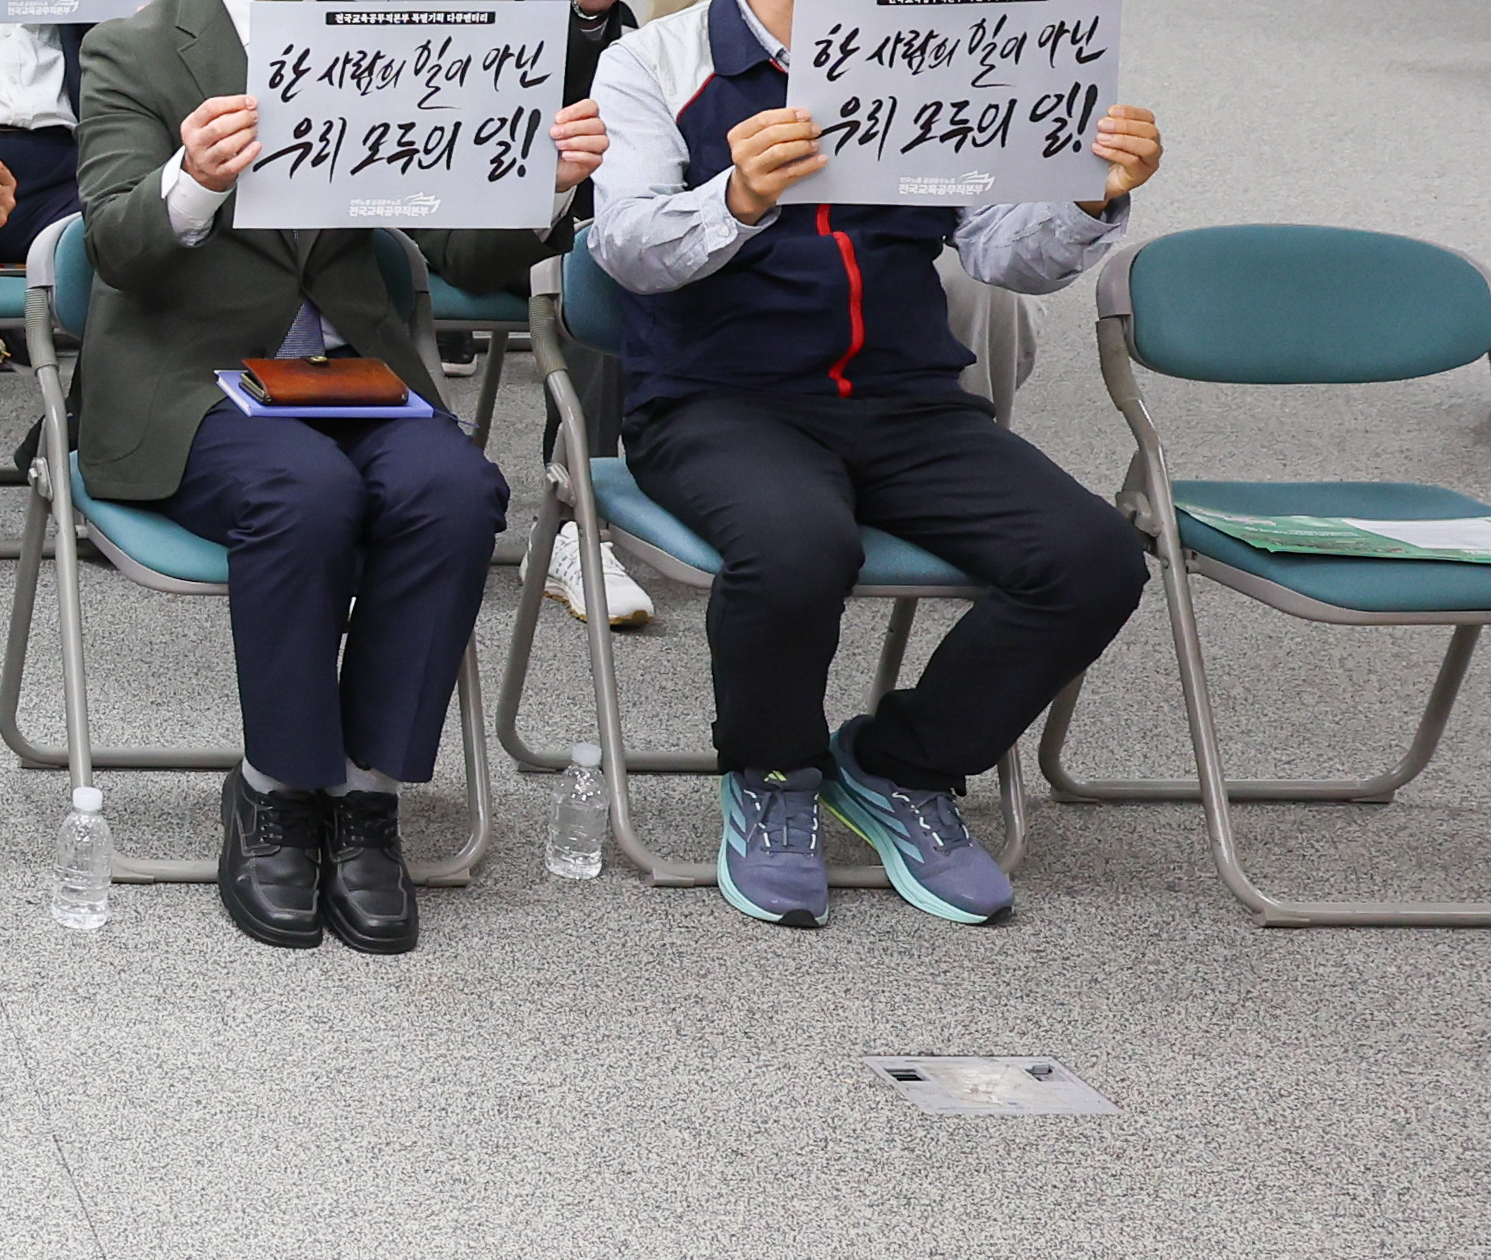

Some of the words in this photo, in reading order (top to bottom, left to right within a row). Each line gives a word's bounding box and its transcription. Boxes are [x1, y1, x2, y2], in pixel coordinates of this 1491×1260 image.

[269, 45, 311, 102] 한
[317, 50, 406, 96] 사람의
[414, 36, 471, 110] 일이
[482, 40, 550, 92] 아닌
[814, 24, 859, 82] 한
[866, 29, 960, 75] 사람의
[968, 14, 1027, 88] 일이
[1038, 16, 1105, 68] 아닌
[255, 117, 346, 183] 우리
[351, 121, 461, 175] 모두의
[473, 104, 540, 183] 일!
[817, 95, 898, 161] 우리
[901, 98, 1017, 155] 모두의
[1029, 81, 1096, 159] 일!
